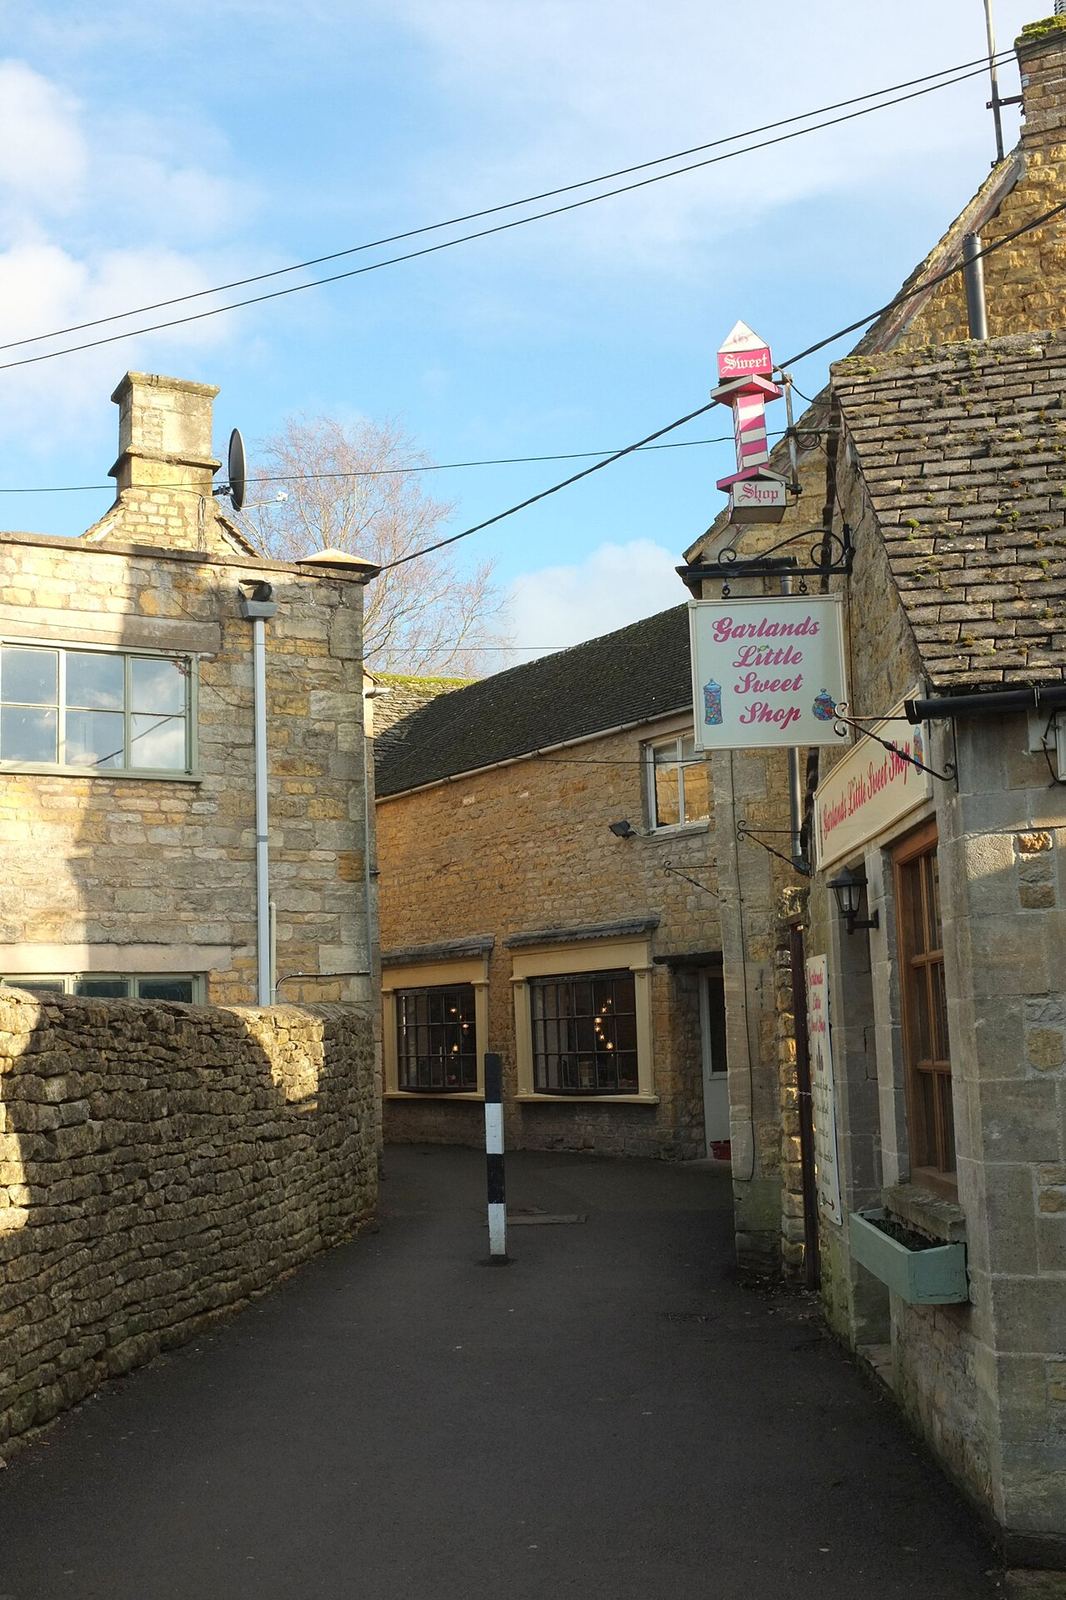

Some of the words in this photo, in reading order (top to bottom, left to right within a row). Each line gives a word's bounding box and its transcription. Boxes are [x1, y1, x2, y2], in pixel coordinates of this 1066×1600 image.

[721, 353, 768, 374] Sweet
[738, 483, 779, 503] Shop
[712, 616, 820, 642] Garlands
[732, 645, 803, 668] Little
[734, 671, 803, 694] Sweet
[739, 702, 801, 729] Shop
[848, 773, 866, 817] Little
[867, 755, 888, 800] Sweet
